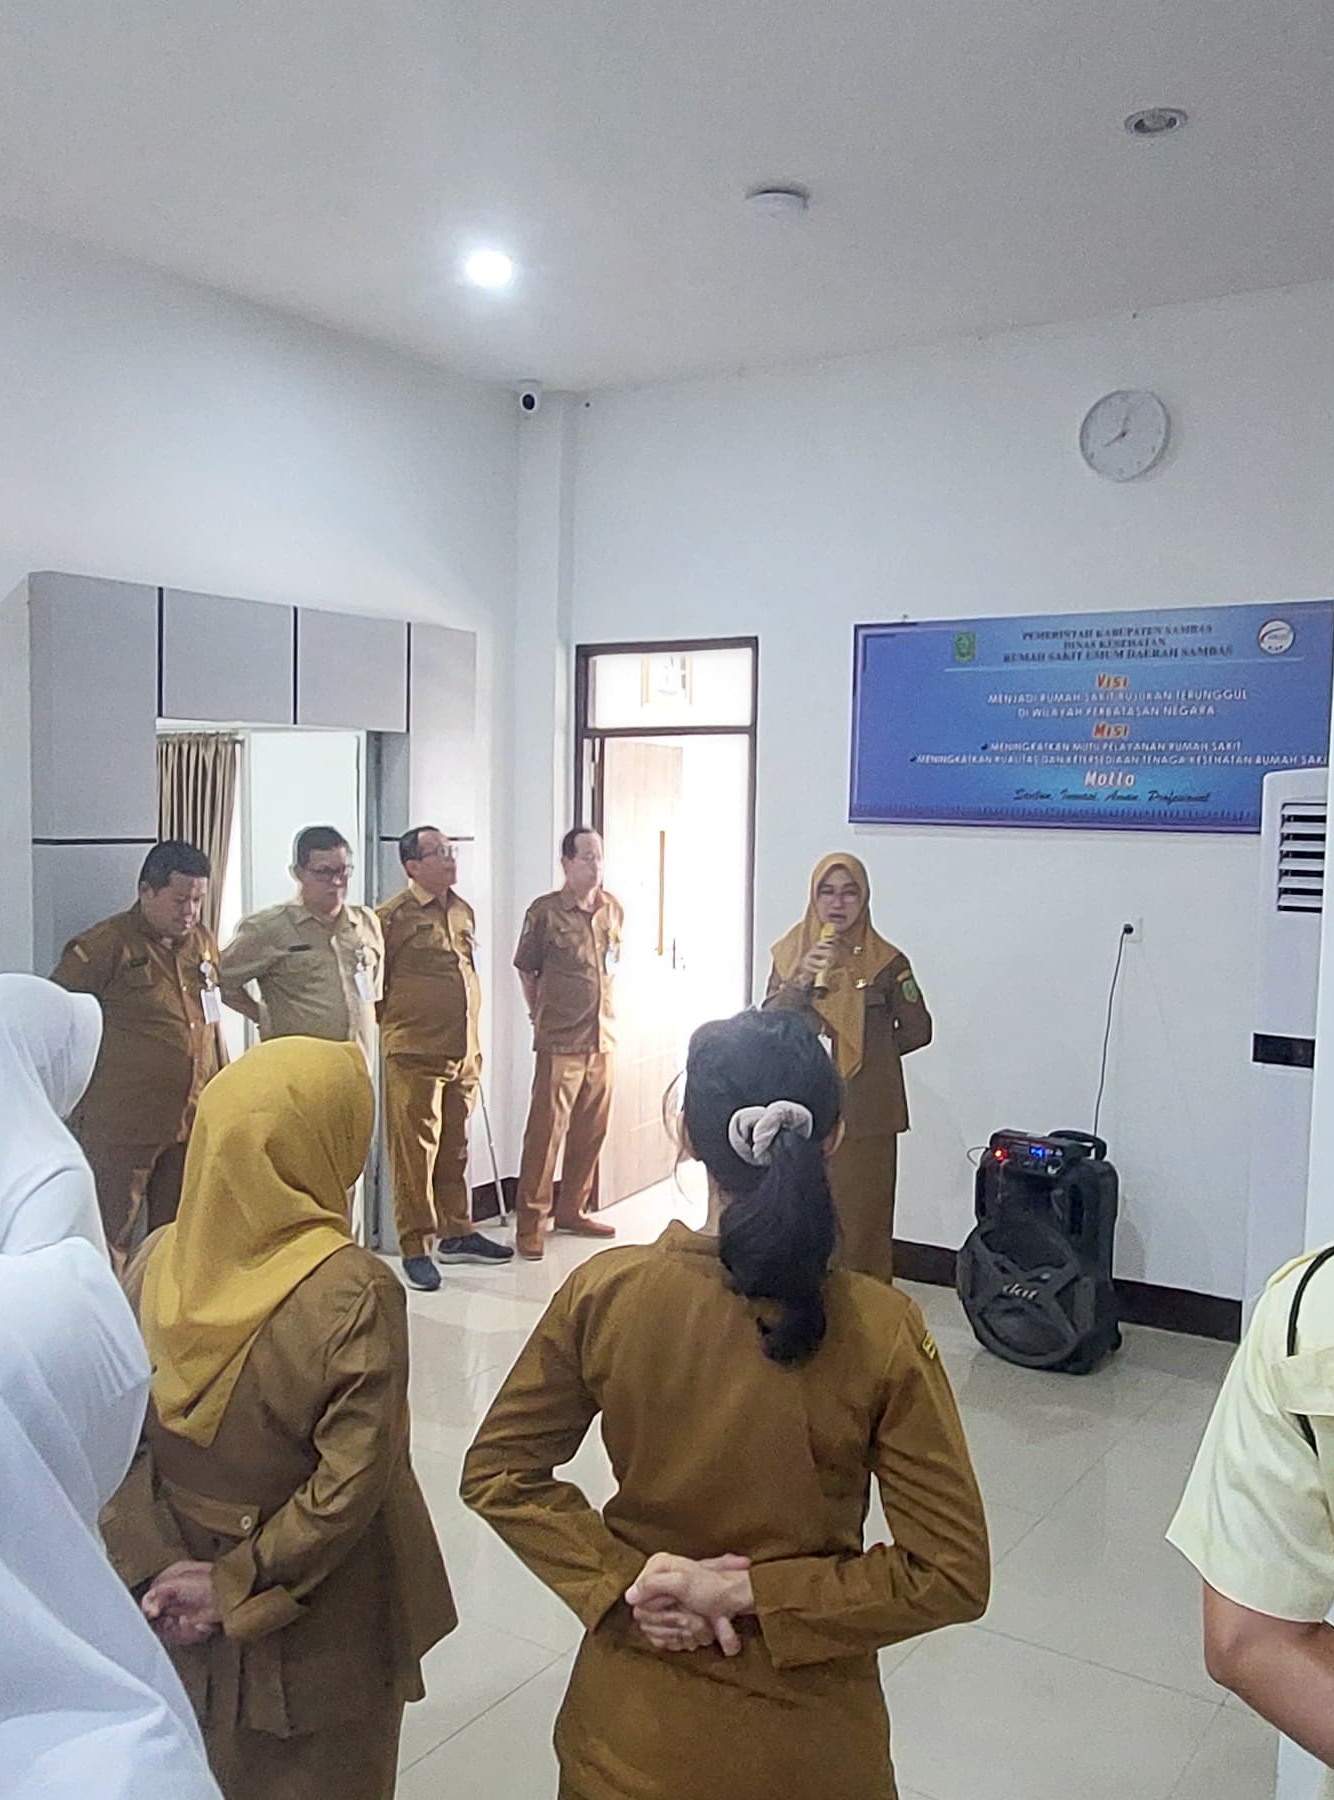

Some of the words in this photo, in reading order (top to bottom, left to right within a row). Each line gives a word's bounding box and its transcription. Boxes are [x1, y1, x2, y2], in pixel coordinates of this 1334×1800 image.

[1040, 692, 1082, 703] RUMAH
[1018, 707, 1030, 719] DI
[1033, 706, 1083, 718] WILAYAH
[1086, 705, 1160, 717] PERBATASAN
[1163, 704, 1216, 717] NEGARA
[991, 741, 1069, 752] MENINGKATKAN
[1103, 741, 1166, 752] PELAYANAN
[1169, 741, 1209, 752] RUMAH
[1212, 740, 1242, 752] SAKIT
[917, 753, 993, 765] MENINGKATKAN
[1143, 755, 1186, 765] TENAGA
[1256, 755, 1298, 765] RUMAH
[1300, 754, 1328, 765] SAKI
